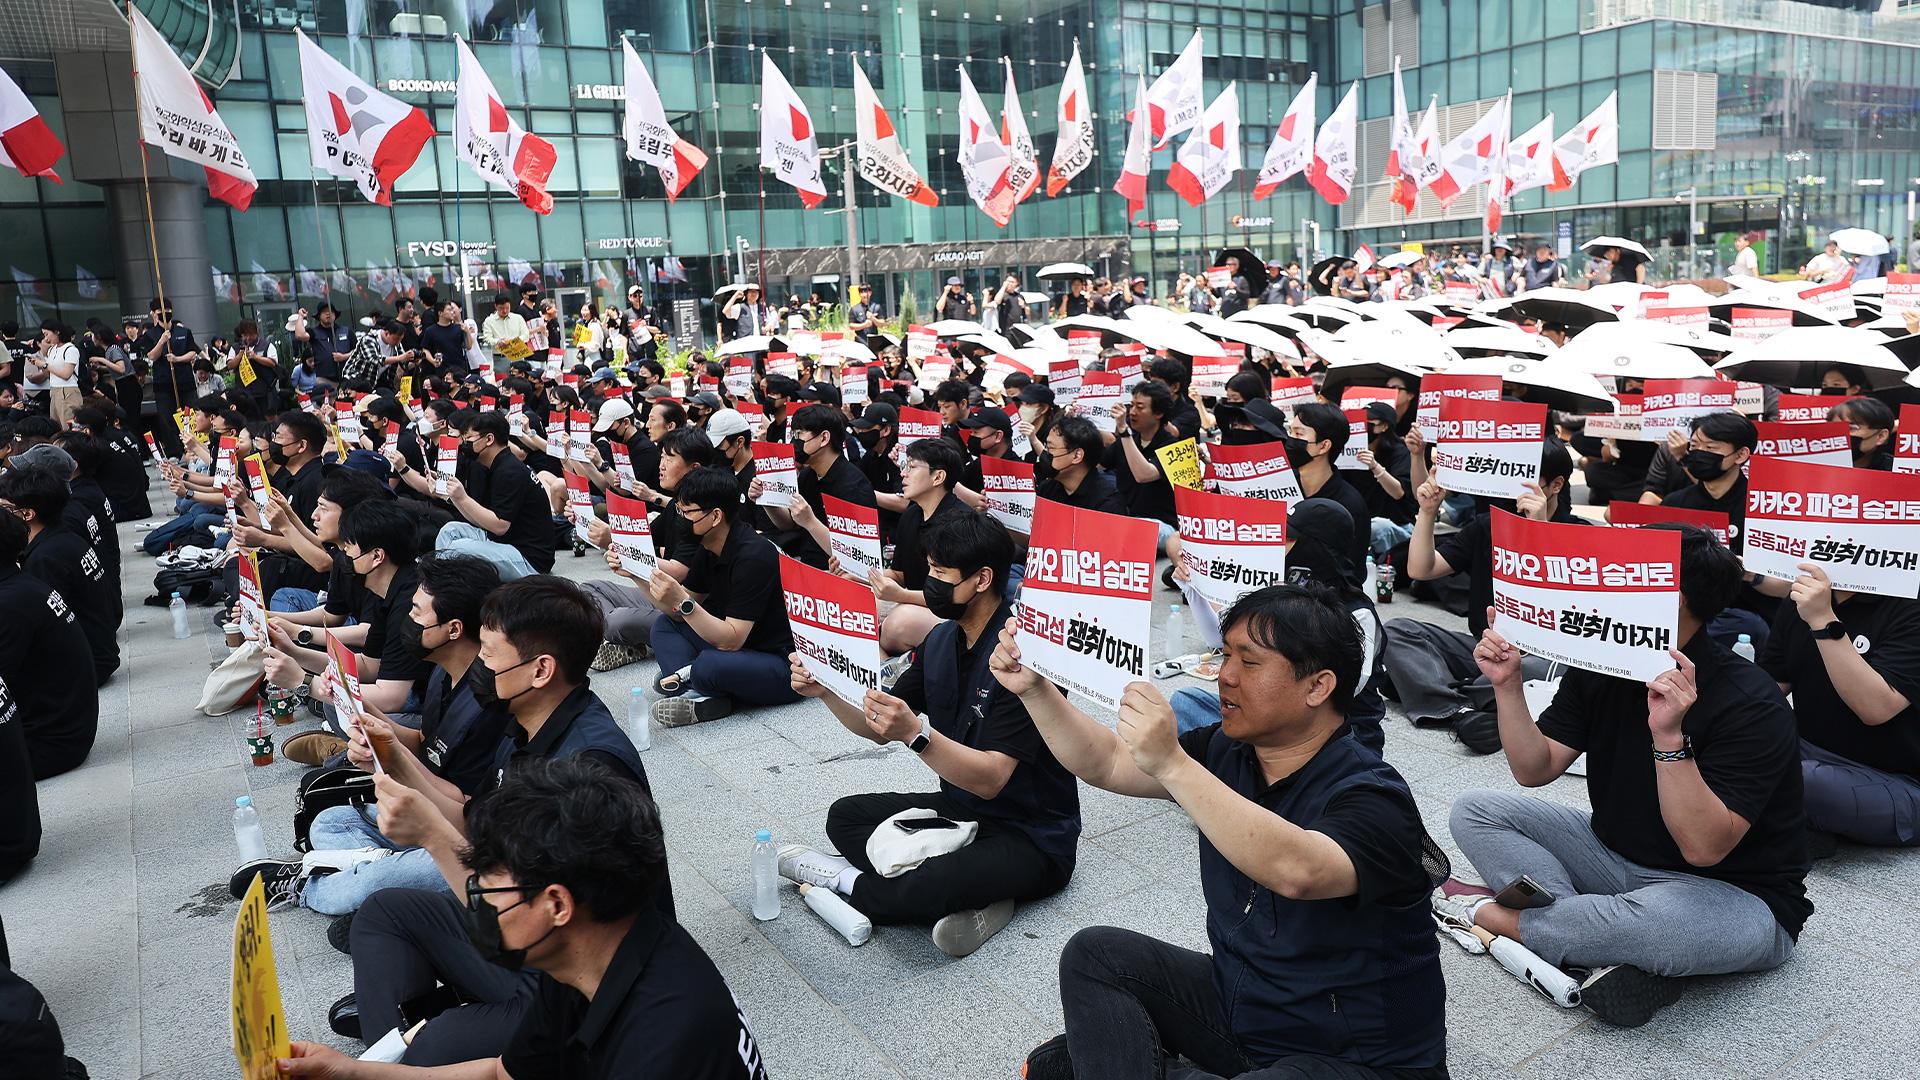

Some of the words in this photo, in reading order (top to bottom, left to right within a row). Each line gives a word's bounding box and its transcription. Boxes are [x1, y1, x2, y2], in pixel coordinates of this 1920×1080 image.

[576, 84, 591, 98] LA
[408, 241, 458, 257] FYSD
[600, 239, 622, 249] RED
[934, 253, 963, 262] KAKAO
[1644, 393, 1674, 409] 카카오
[1674, 392, 1700, 406] 파업
[1701, 394, 1733, 406] 승리로
[1462, 420, 1495, 439] 파업
[1497, 423, 1541, 439] 승리로
[1777, 438, 1807, 454] 파업
[1809, 436, 1849, 452] 승리로
[1231, 460, 1255, 478] 파업
[1256, 456, 1290, 474] 승리로
[1001, 475, 1018, 490] 파업
[1016, 479, 1034, 490] 승리로
[1749, 490, 1803, 517] 카카오
[1806, 493, 1859, 519] 파업
[1862, 500, 1920, 521] 승리로
[858, 524, 878, 537] 승리로
[1205, 519, 1235, 541] 파업
[1237, 524, 1283, 542] 승리로
[1748, 528, 1807, 558] 공동교섭
[1809, 539, 1919, 571] 쟁취하자!
[1025, 546, 1059, 583] 카카오
[1060, 549, 1101, 587] 파업
[1103, 560, 1151, 594] 승리로
[1493, 546, 1543, 582] 카카오
[1544, 556, 1599, 586] 파업
[1601, 562, 1675, 587] 승리로
[816, 599, 842, 628] 파업
[841, 610, 877, 636] 승리로
[1494, 590, 1556, 631] 공동교섭
[1559, 608, 1670, 651] 쟁취하자!
[1066, 617, 1144, 677] 쟁취하자!
